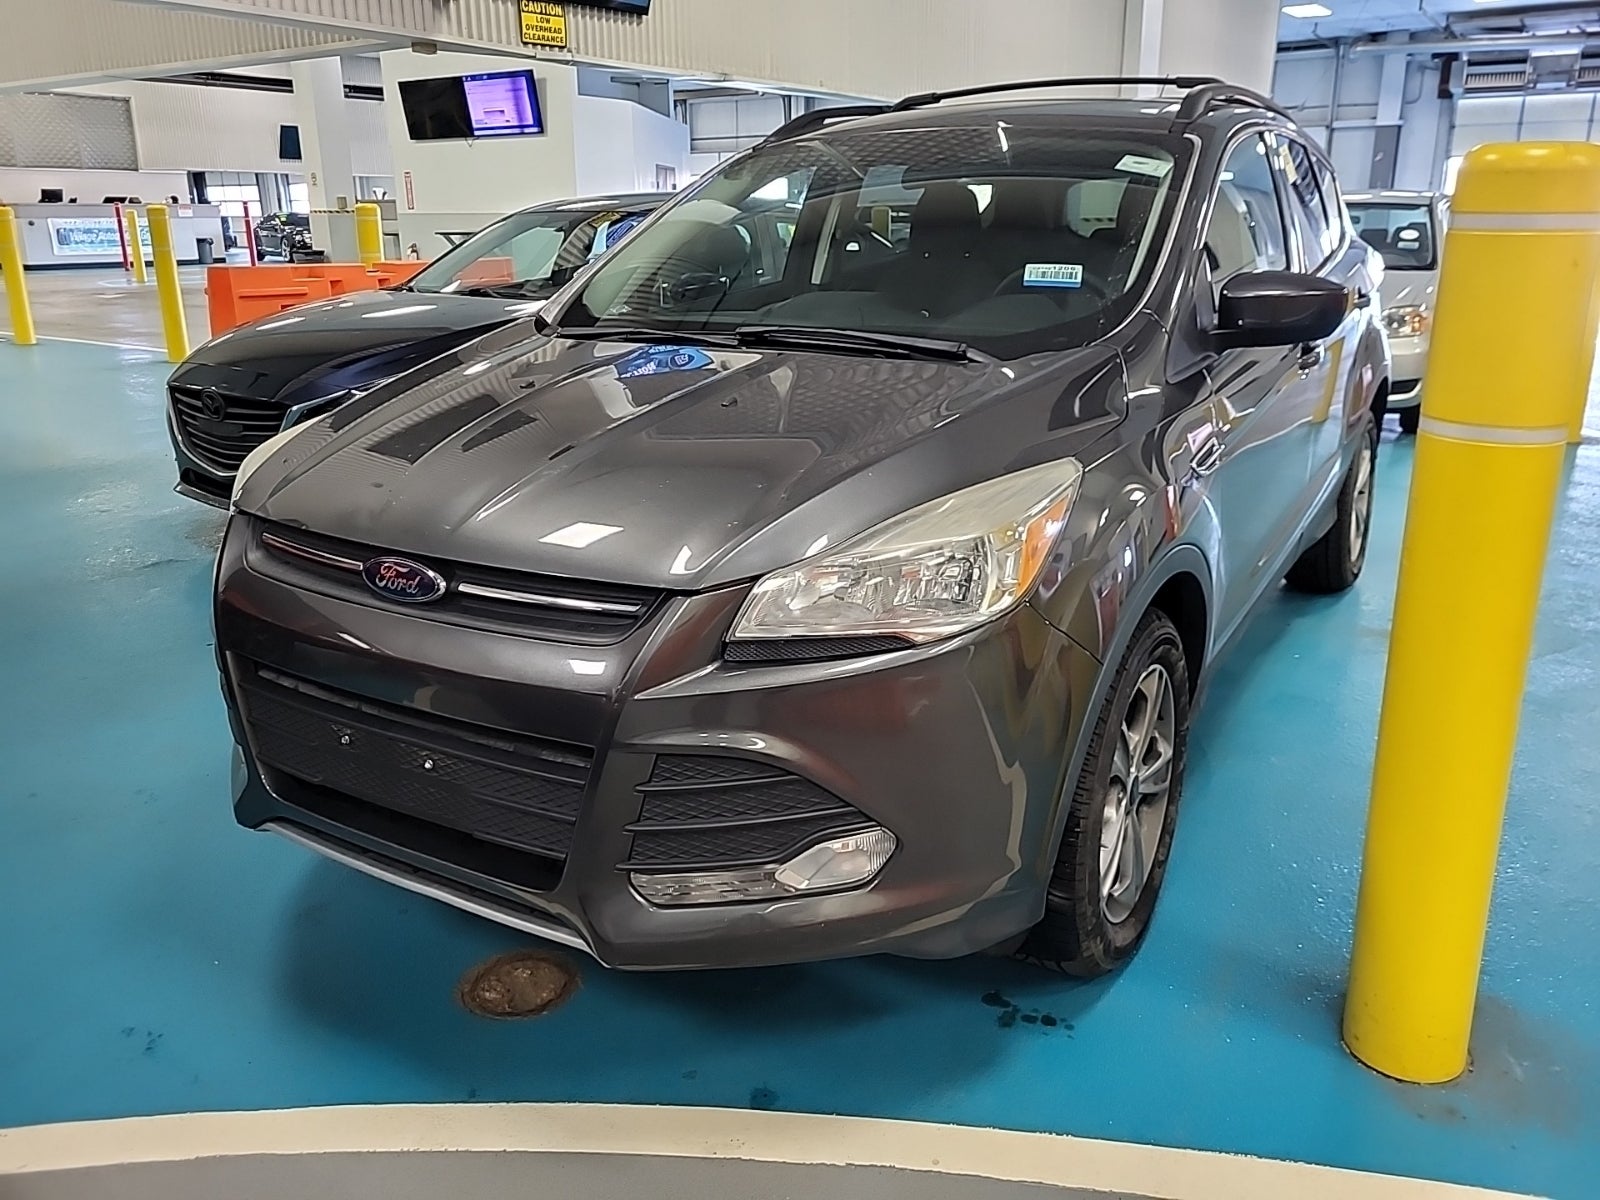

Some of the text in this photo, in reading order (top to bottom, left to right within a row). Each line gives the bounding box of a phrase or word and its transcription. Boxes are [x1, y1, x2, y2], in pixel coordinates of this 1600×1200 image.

[522, 0, 563, 16] CAUTION
[535, 15, 551, 24] LOW
[525, 23, 563, 35] OVERHEAD
[523, 32, 565, 44] CLEARANCE
[375, 562, 421, 594] Ford
